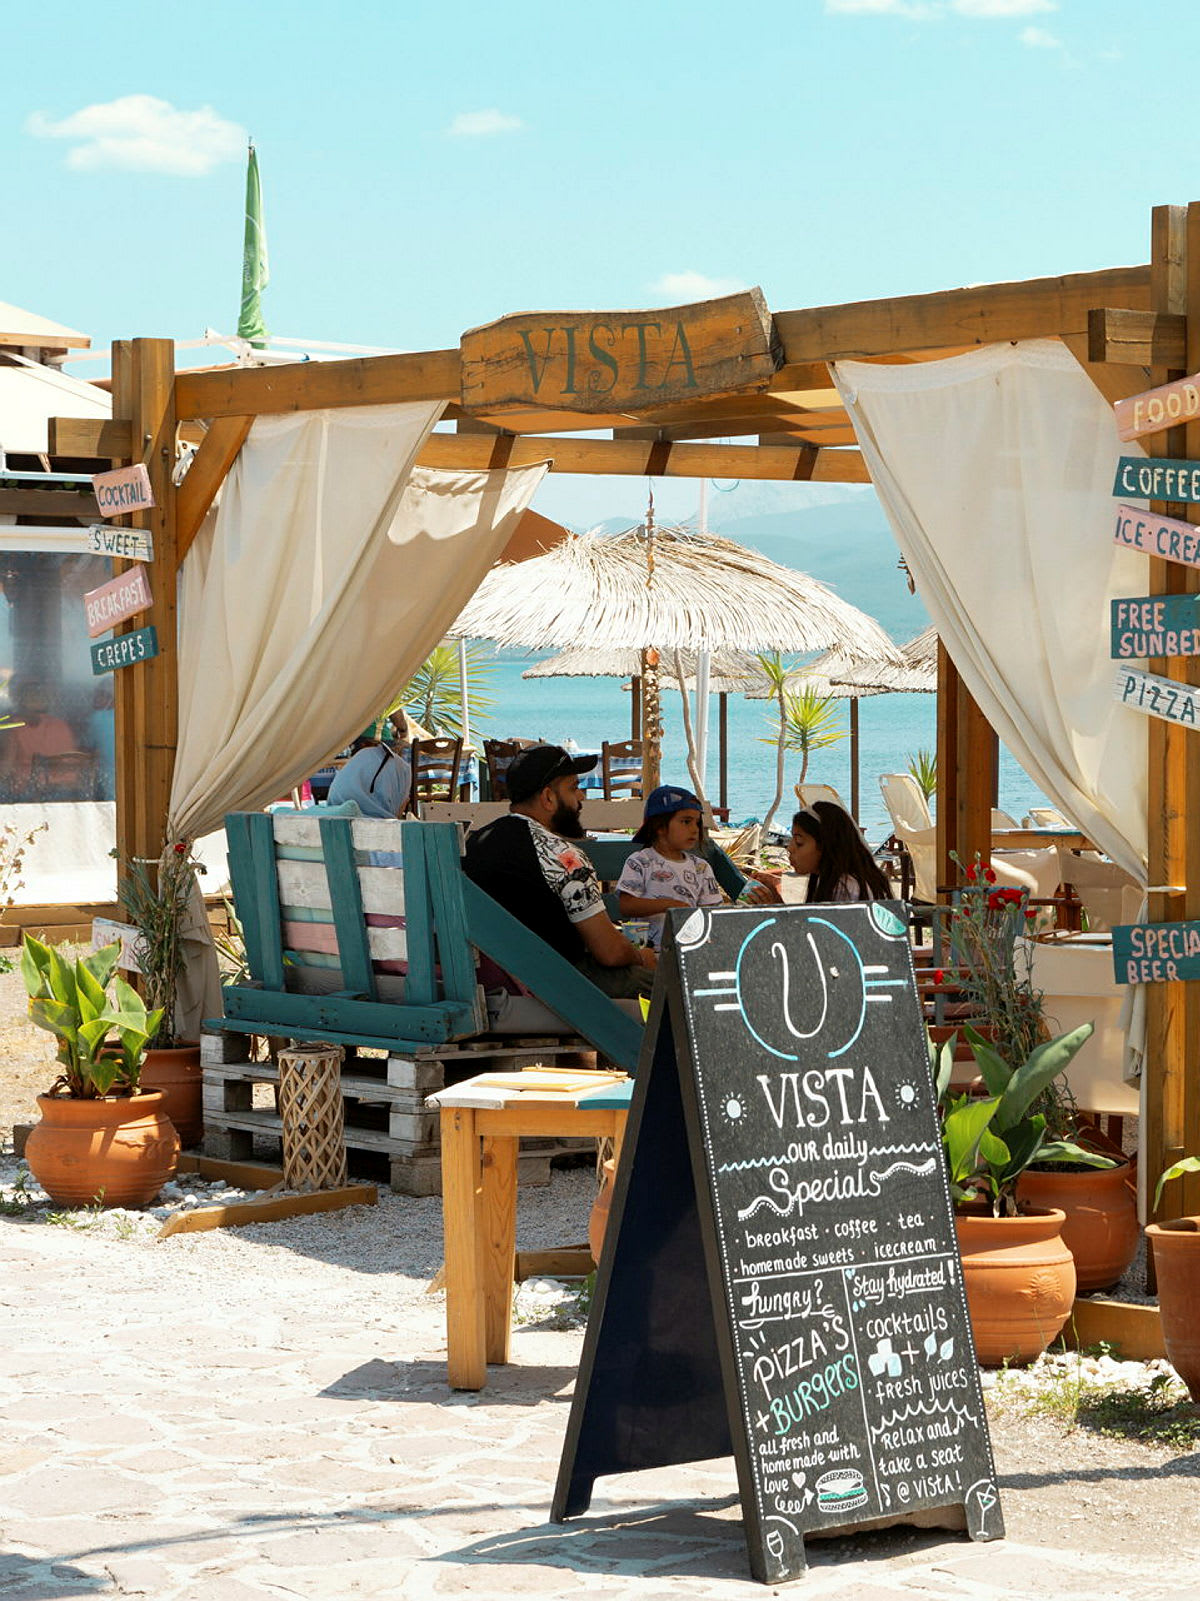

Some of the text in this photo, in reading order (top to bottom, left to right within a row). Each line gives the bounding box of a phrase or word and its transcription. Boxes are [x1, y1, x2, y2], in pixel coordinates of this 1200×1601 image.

[515, 320, 699, 395] VISTA
[1133, 383, 1200, 432] FOOD
[99, 480, 147, 507] COCKTAIL
[94, 529, 140, 558] SWEET
[1115, 515, 1146, 548] ICE
[87, 575, 147, 629] BREAKFAST
[1117, 601, 1167, 632] FREE
[97, 633, 146, 668] CREPES
[1122, 675, 1196, 724] PIZZA
[1126, 959, 1181, 985] BEER
[755, 1065, 891, 1130] VISTA
[822, 1131, 868, 1166] daily
[768, 1166, 882, 1217] Specials
[745, 1212, 925, 1249] breakfast coffee tea
[741, 1252, 808, 1277] homemade
[812, 1248, 855, 1268] sweets
[852, 1273, 885, 1306] Stay
[866, 1303, 949, 1339] cocktails
[875, 1366, 969, 1405] fresh juices
[758, 1424, 840, 1456] all fresh and
[925, 1415, 953, 1441] and
[760, 1442, 861, 1475] homemade with
[878, 1443, 964, 1477] take a seat
[763, 1476, 790, 1495] love
